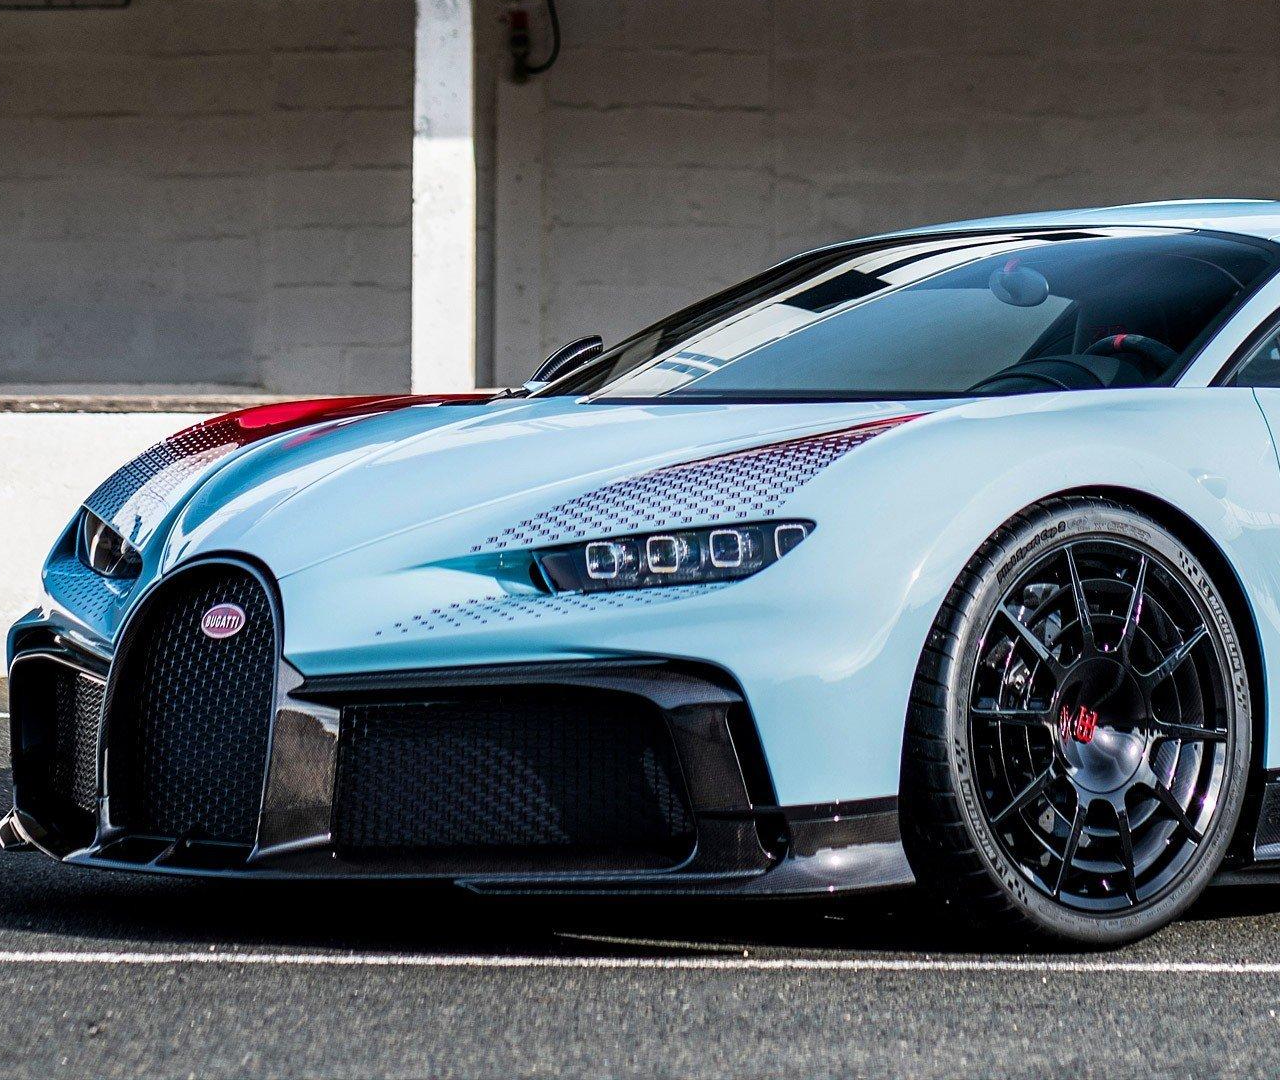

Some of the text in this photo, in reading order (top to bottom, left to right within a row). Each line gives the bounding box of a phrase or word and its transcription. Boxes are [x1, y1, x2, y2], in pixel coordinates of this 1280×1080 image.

[205, 615, 240, 629] BUGATTI
[1207, 594, 1242, 670] MICHELIN
[962, 781, 997, 860] MICHELIN
